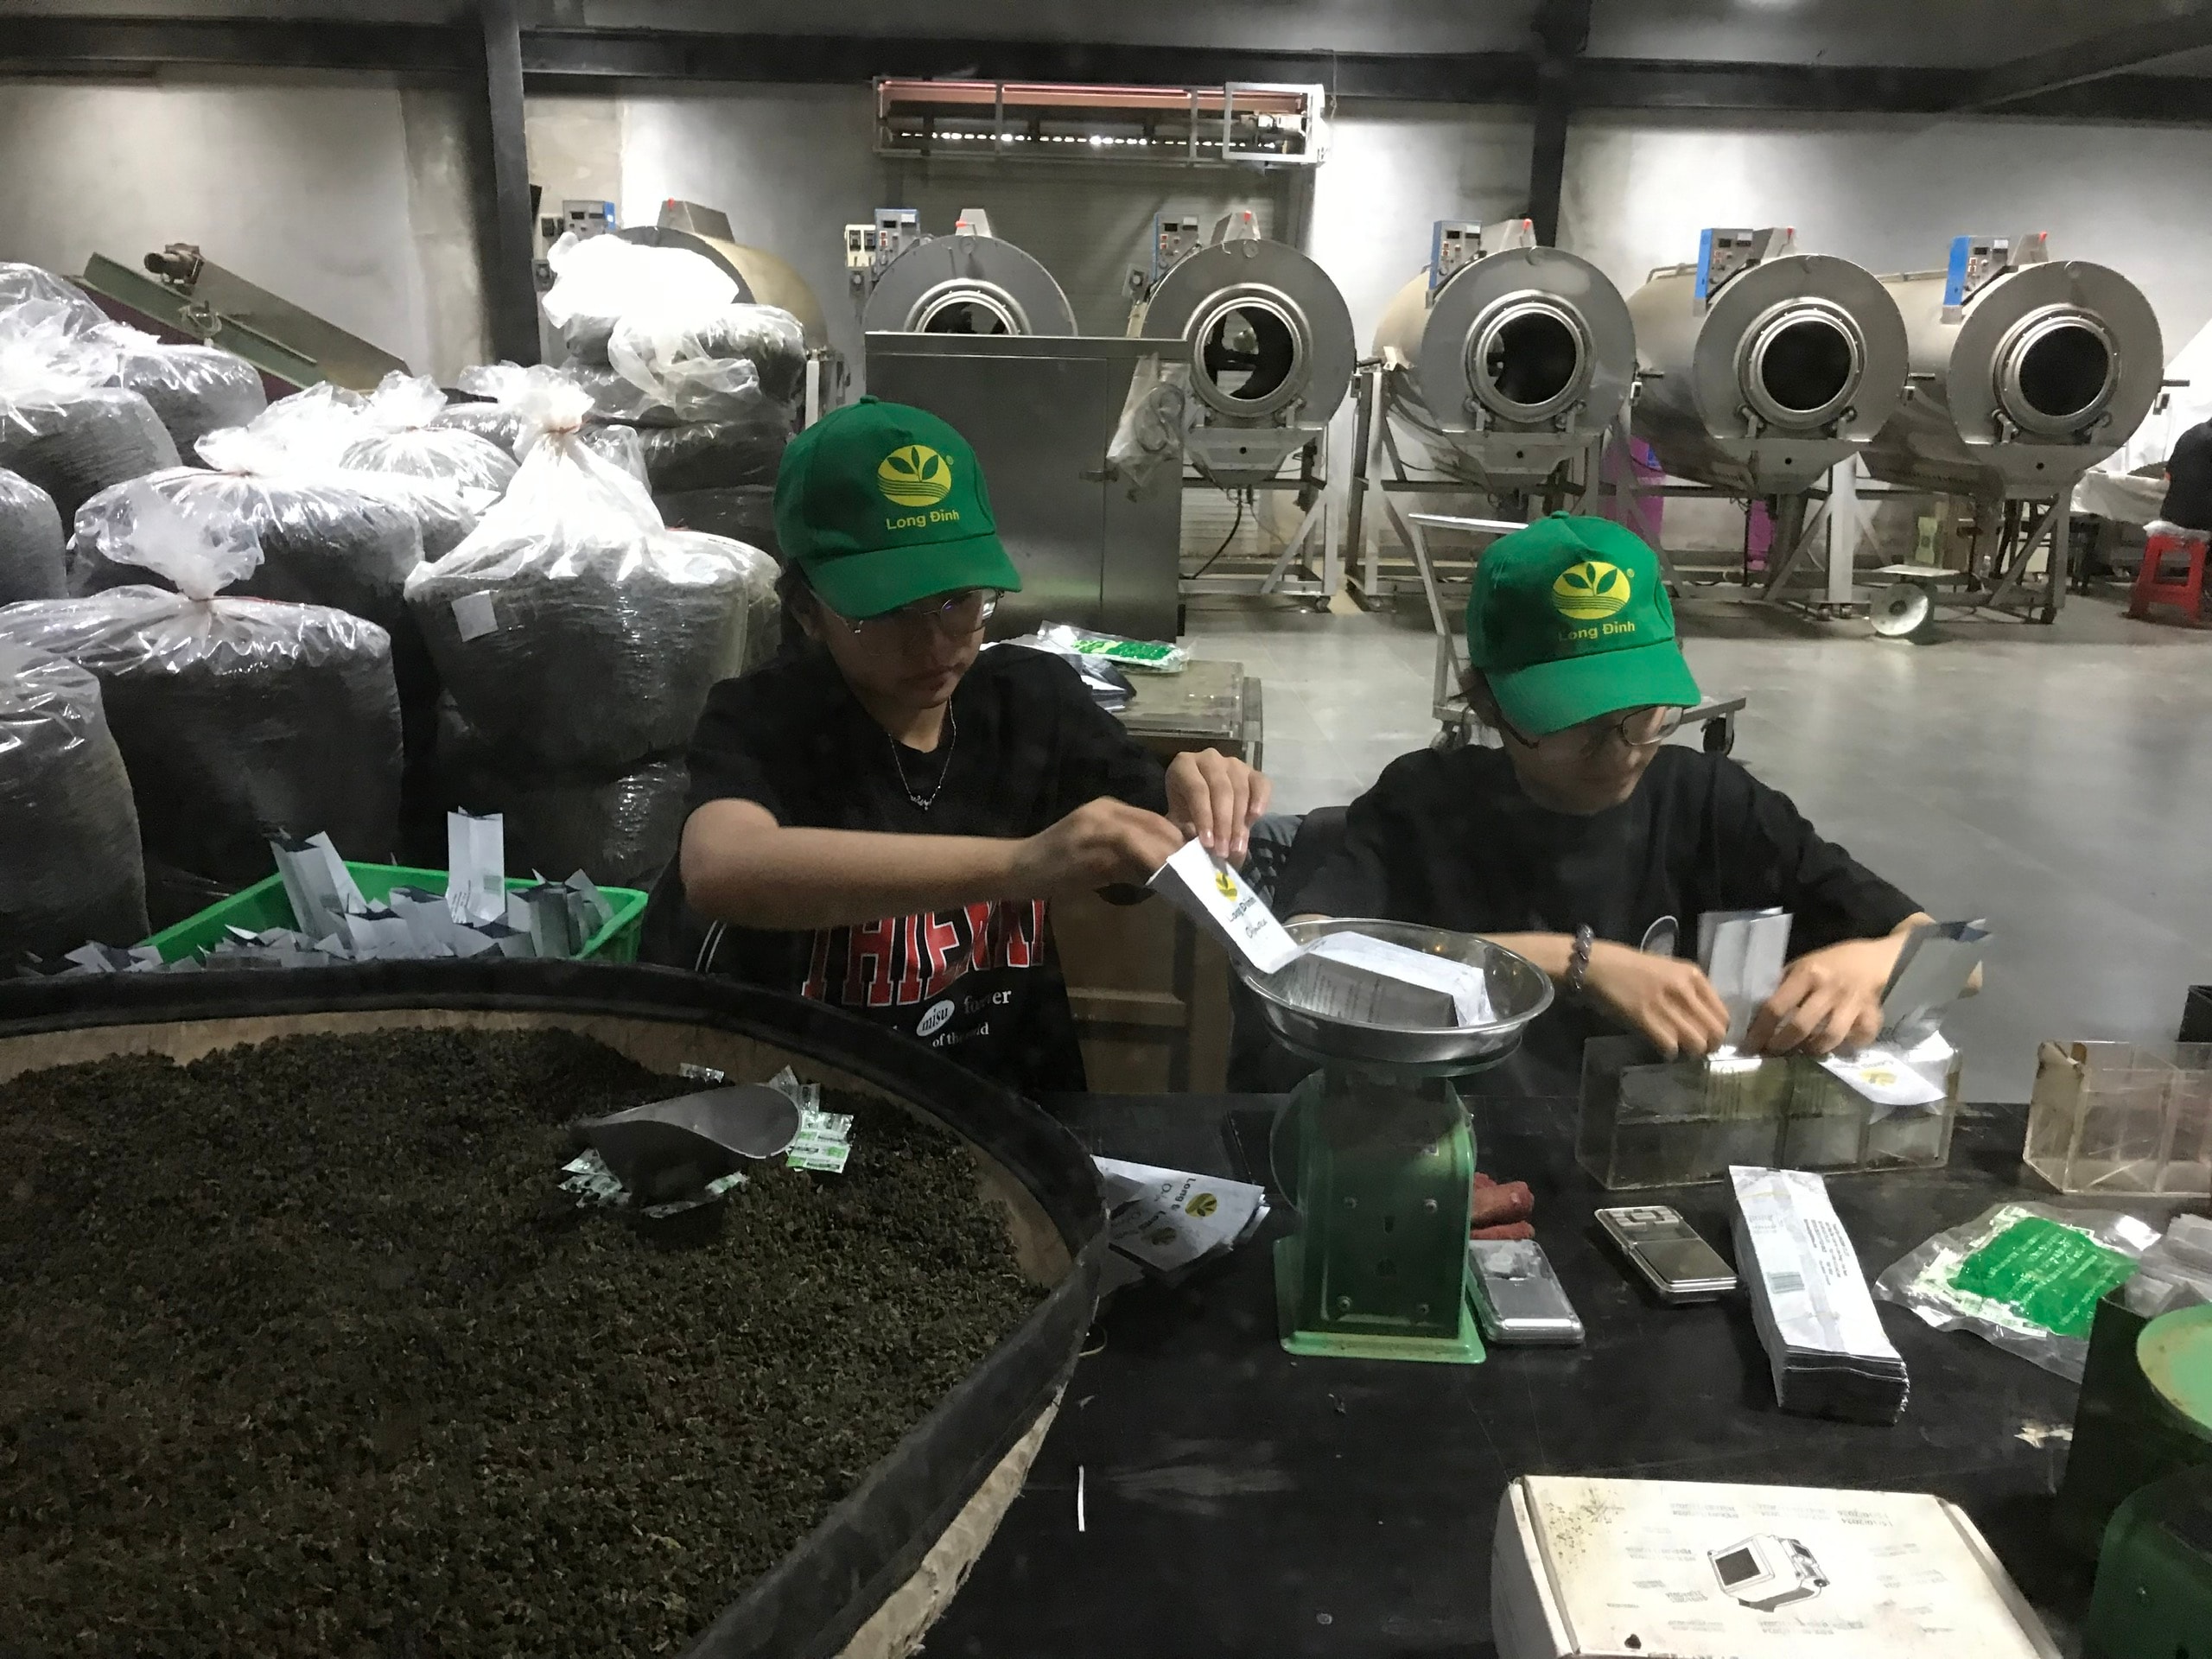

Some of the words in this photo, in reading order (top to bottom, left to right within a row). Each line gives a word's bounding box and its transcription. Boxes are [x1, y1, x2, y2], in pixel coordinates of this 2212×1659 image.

[887, 515, 926, 530] Long
[1559, 627, 1598, 641] Long
[922, 1007, 949, 1032] misu
[932, 1033, 946, 1047] of
[1175, 1178, 1197, 1203] Long
